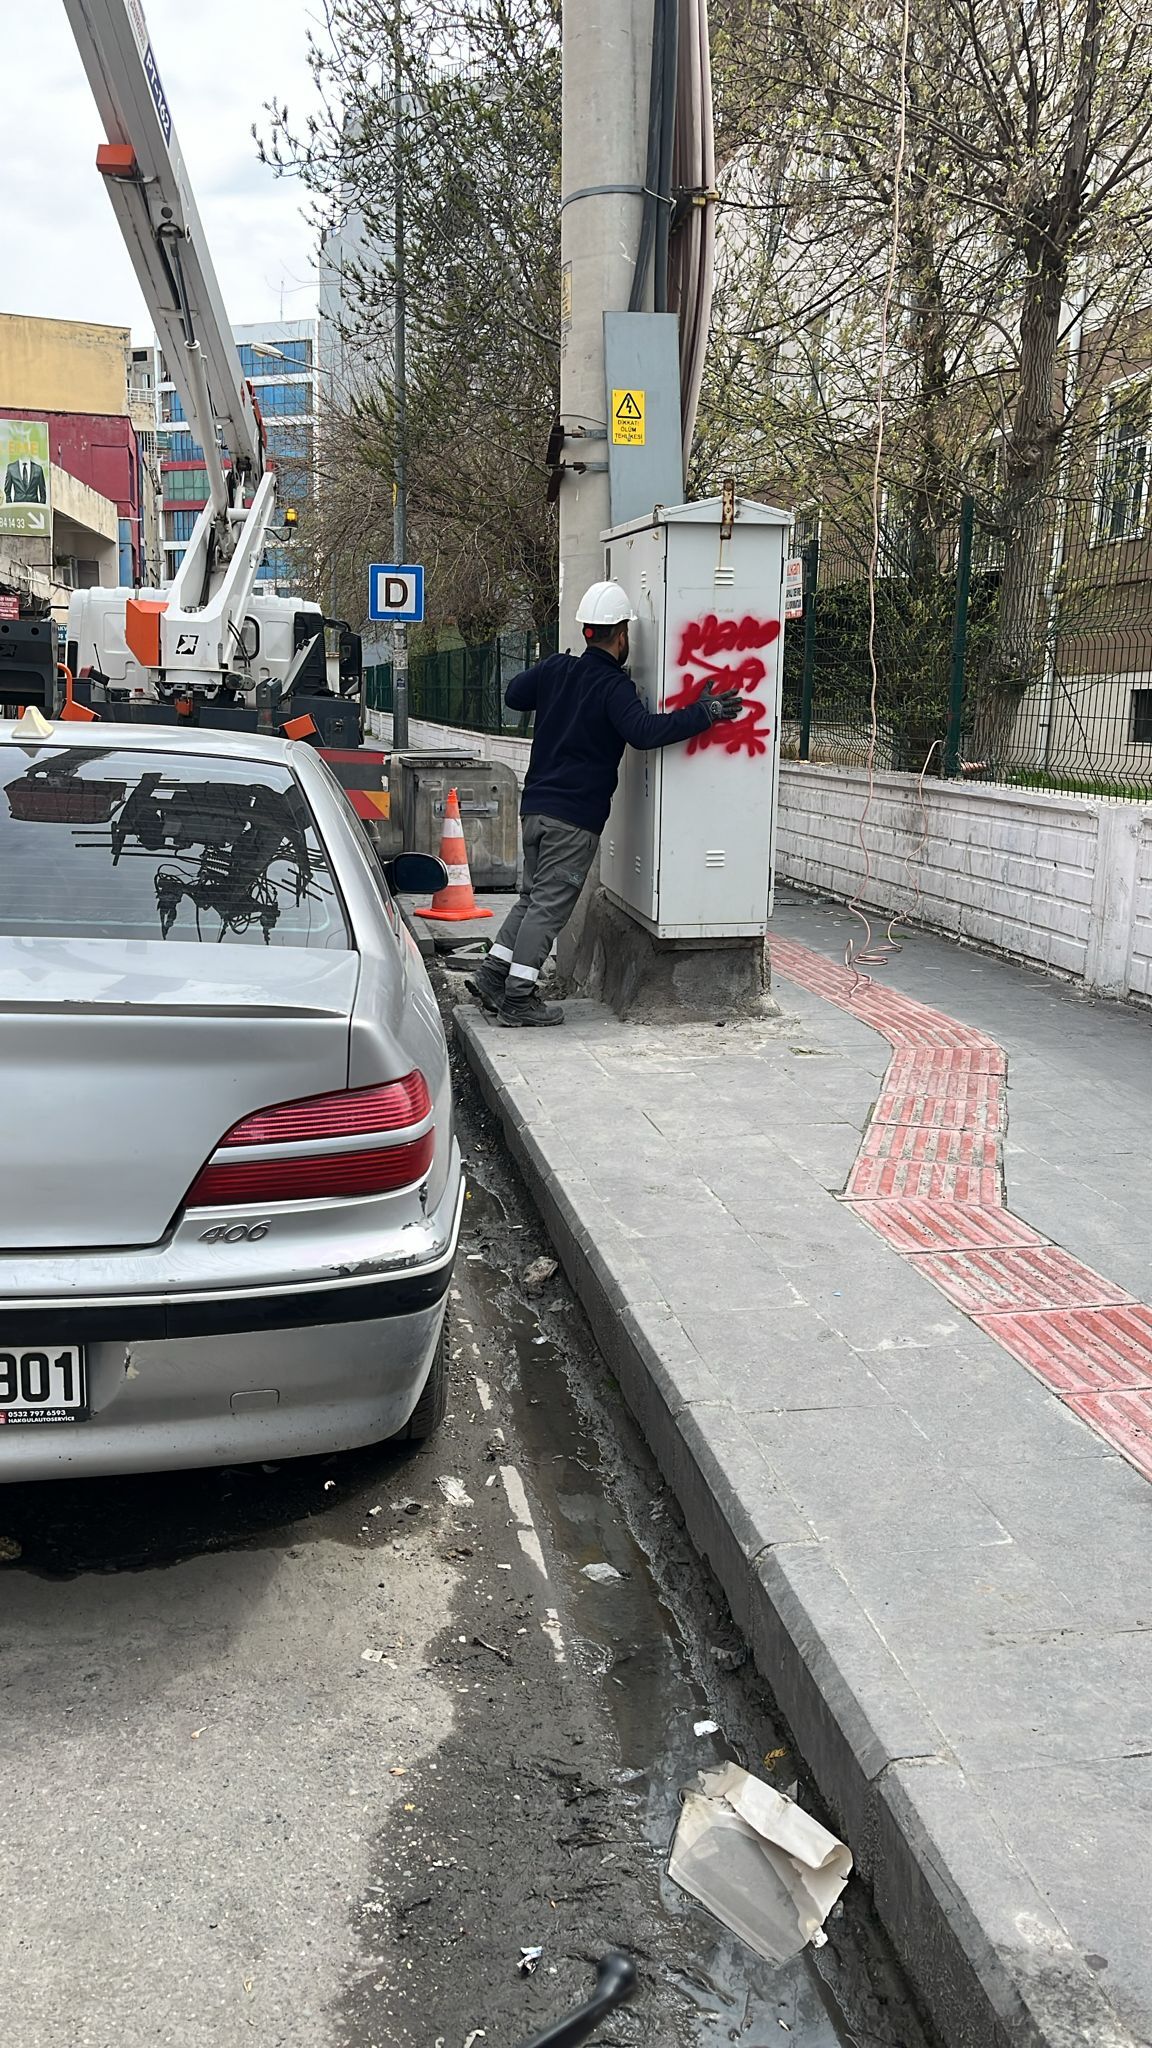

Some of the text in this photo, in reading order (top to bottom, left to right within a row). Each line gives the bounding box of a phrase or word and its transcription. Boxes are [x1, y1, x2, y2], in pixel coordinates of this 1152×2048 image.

[146, 50, 170, 135] PT-162
[16, 518, 25, 529] 33
[385, 577, 409, 608] D
[198, 1219, 272, 1244] 406
